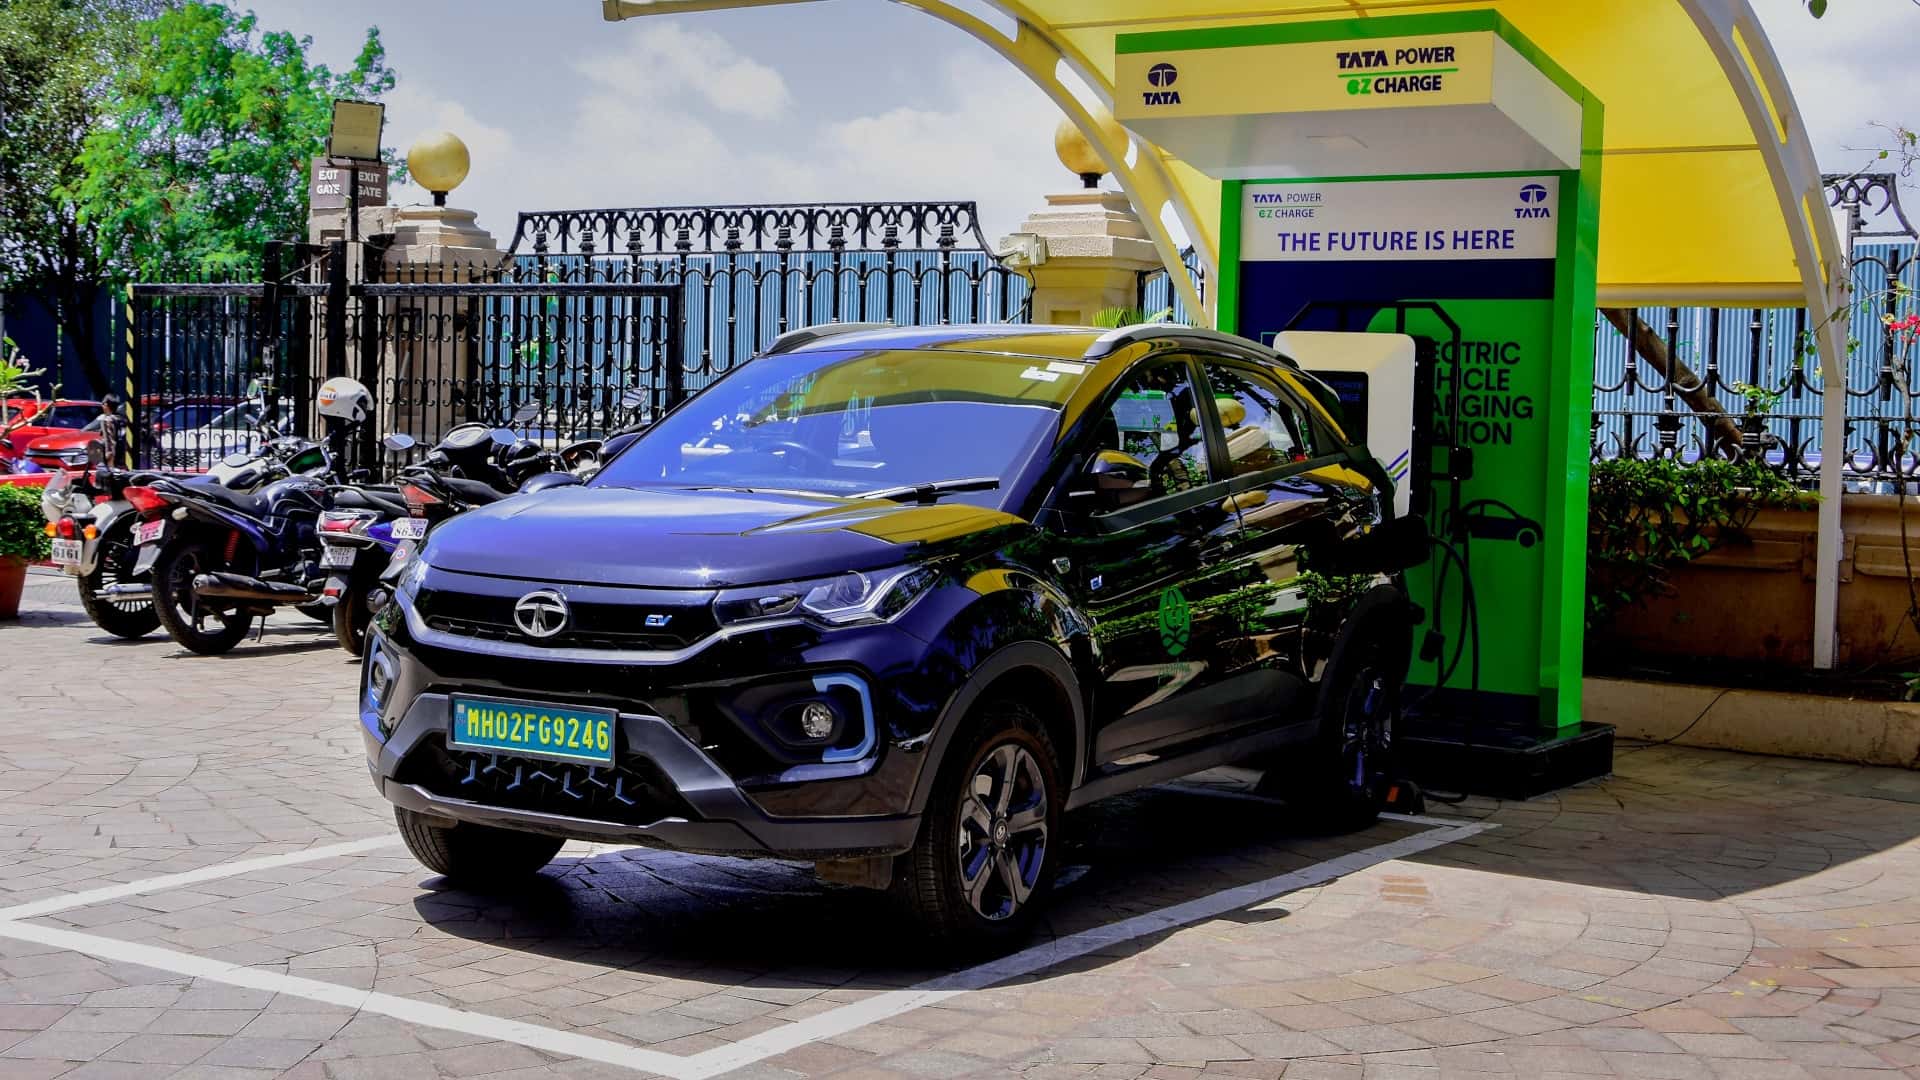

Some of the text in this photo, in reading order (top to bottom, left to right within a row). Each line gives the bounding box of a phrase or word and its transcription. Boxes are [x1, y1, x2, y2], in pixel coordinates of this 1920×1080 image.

[1336, 46, 1455, 69] TATA POWER
[1374, 75, 1442, 93] CHARGE
[1143, 91, 1181, 105] TATA
[318, 170, 338, 180] EXIT
[358, 171, 380, 183] EXIT
[316, 183, 341, 195] GATE
[1252, 192, 1322, 203] TATA POWER
[1274, 208, 1315, 218] CHARGE
[1514, 207, 1550, 218] TATA
[1278, 229, 1515, 251] THE FUTURE IS HERE
[53, 547, 79, 560] 6161
[644, 614, 673, 627] EV
[467, 708, 609, 751] MH02FG9246
